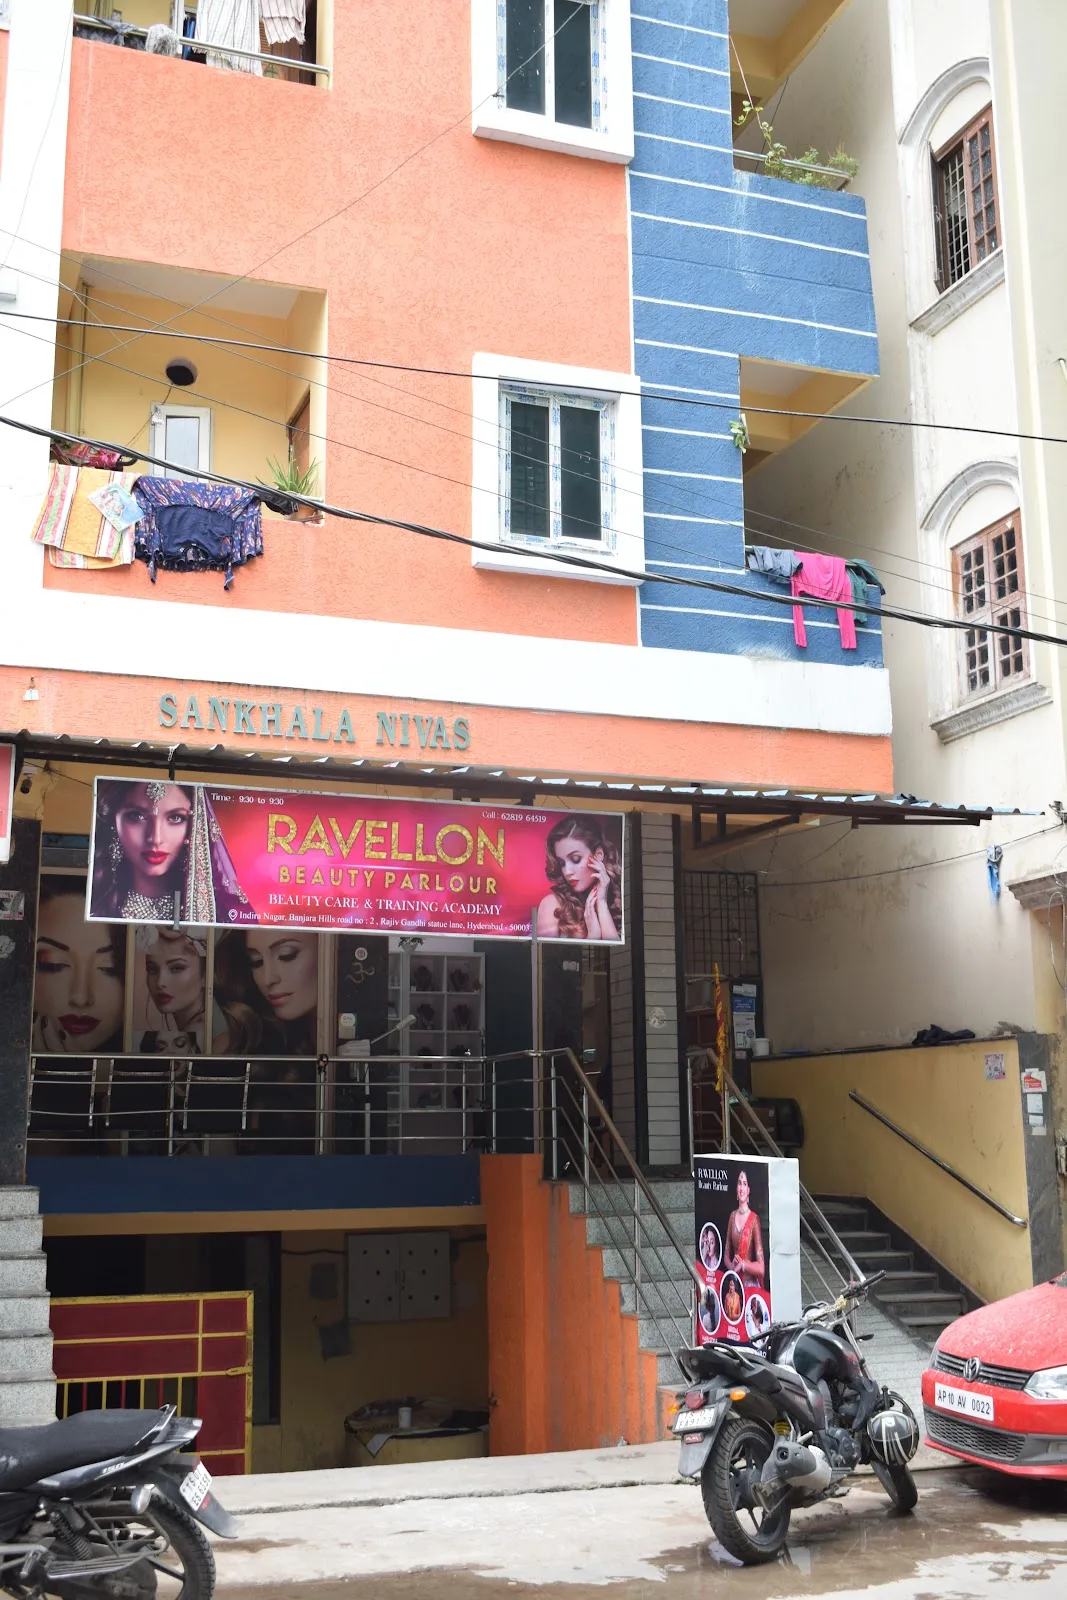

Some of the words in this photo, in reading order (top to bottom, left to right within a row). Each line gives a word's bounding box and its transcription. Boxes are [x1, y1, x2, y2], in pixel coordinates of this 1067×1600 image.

[158, 692, 356, 743] SANKHALA
[376, 711, 471, 751] NIVAS
[257, 797, 266, 805] to
[501, 812, 523, 821] 62819
[525, 814, 547, 823] 64519
[266, 813, 506, 870] RAVELLON
[278, 865, 375, 888] BEAUTY
[384, 871, 498, 895] PARLOUR
[269, 893, 323, 907] BEAUTY
[324, 896, 359, 909] CARE
[363, 898, 374, 910] &
[375, 898, 439, 913] TRAINING
[440, 901, 503, 916] ACADEMY
[239, 910, 261, 920] Indira
[289, 913, 317, 924] Banjara
[318, 914, 336, 923] Hills
[337, 915, 353, 924] road
[354, 917, 364, 925] no
[380, 917, 400, 927] Rajiv
[400, 918, 426, 928] Gandhi
[427, 919, 447, 929] statue
[467, 921, 504, 932] Hyderabad
[957, 1395, 967, 1409] AV
[971, 1398, 991, 1416] 0022
